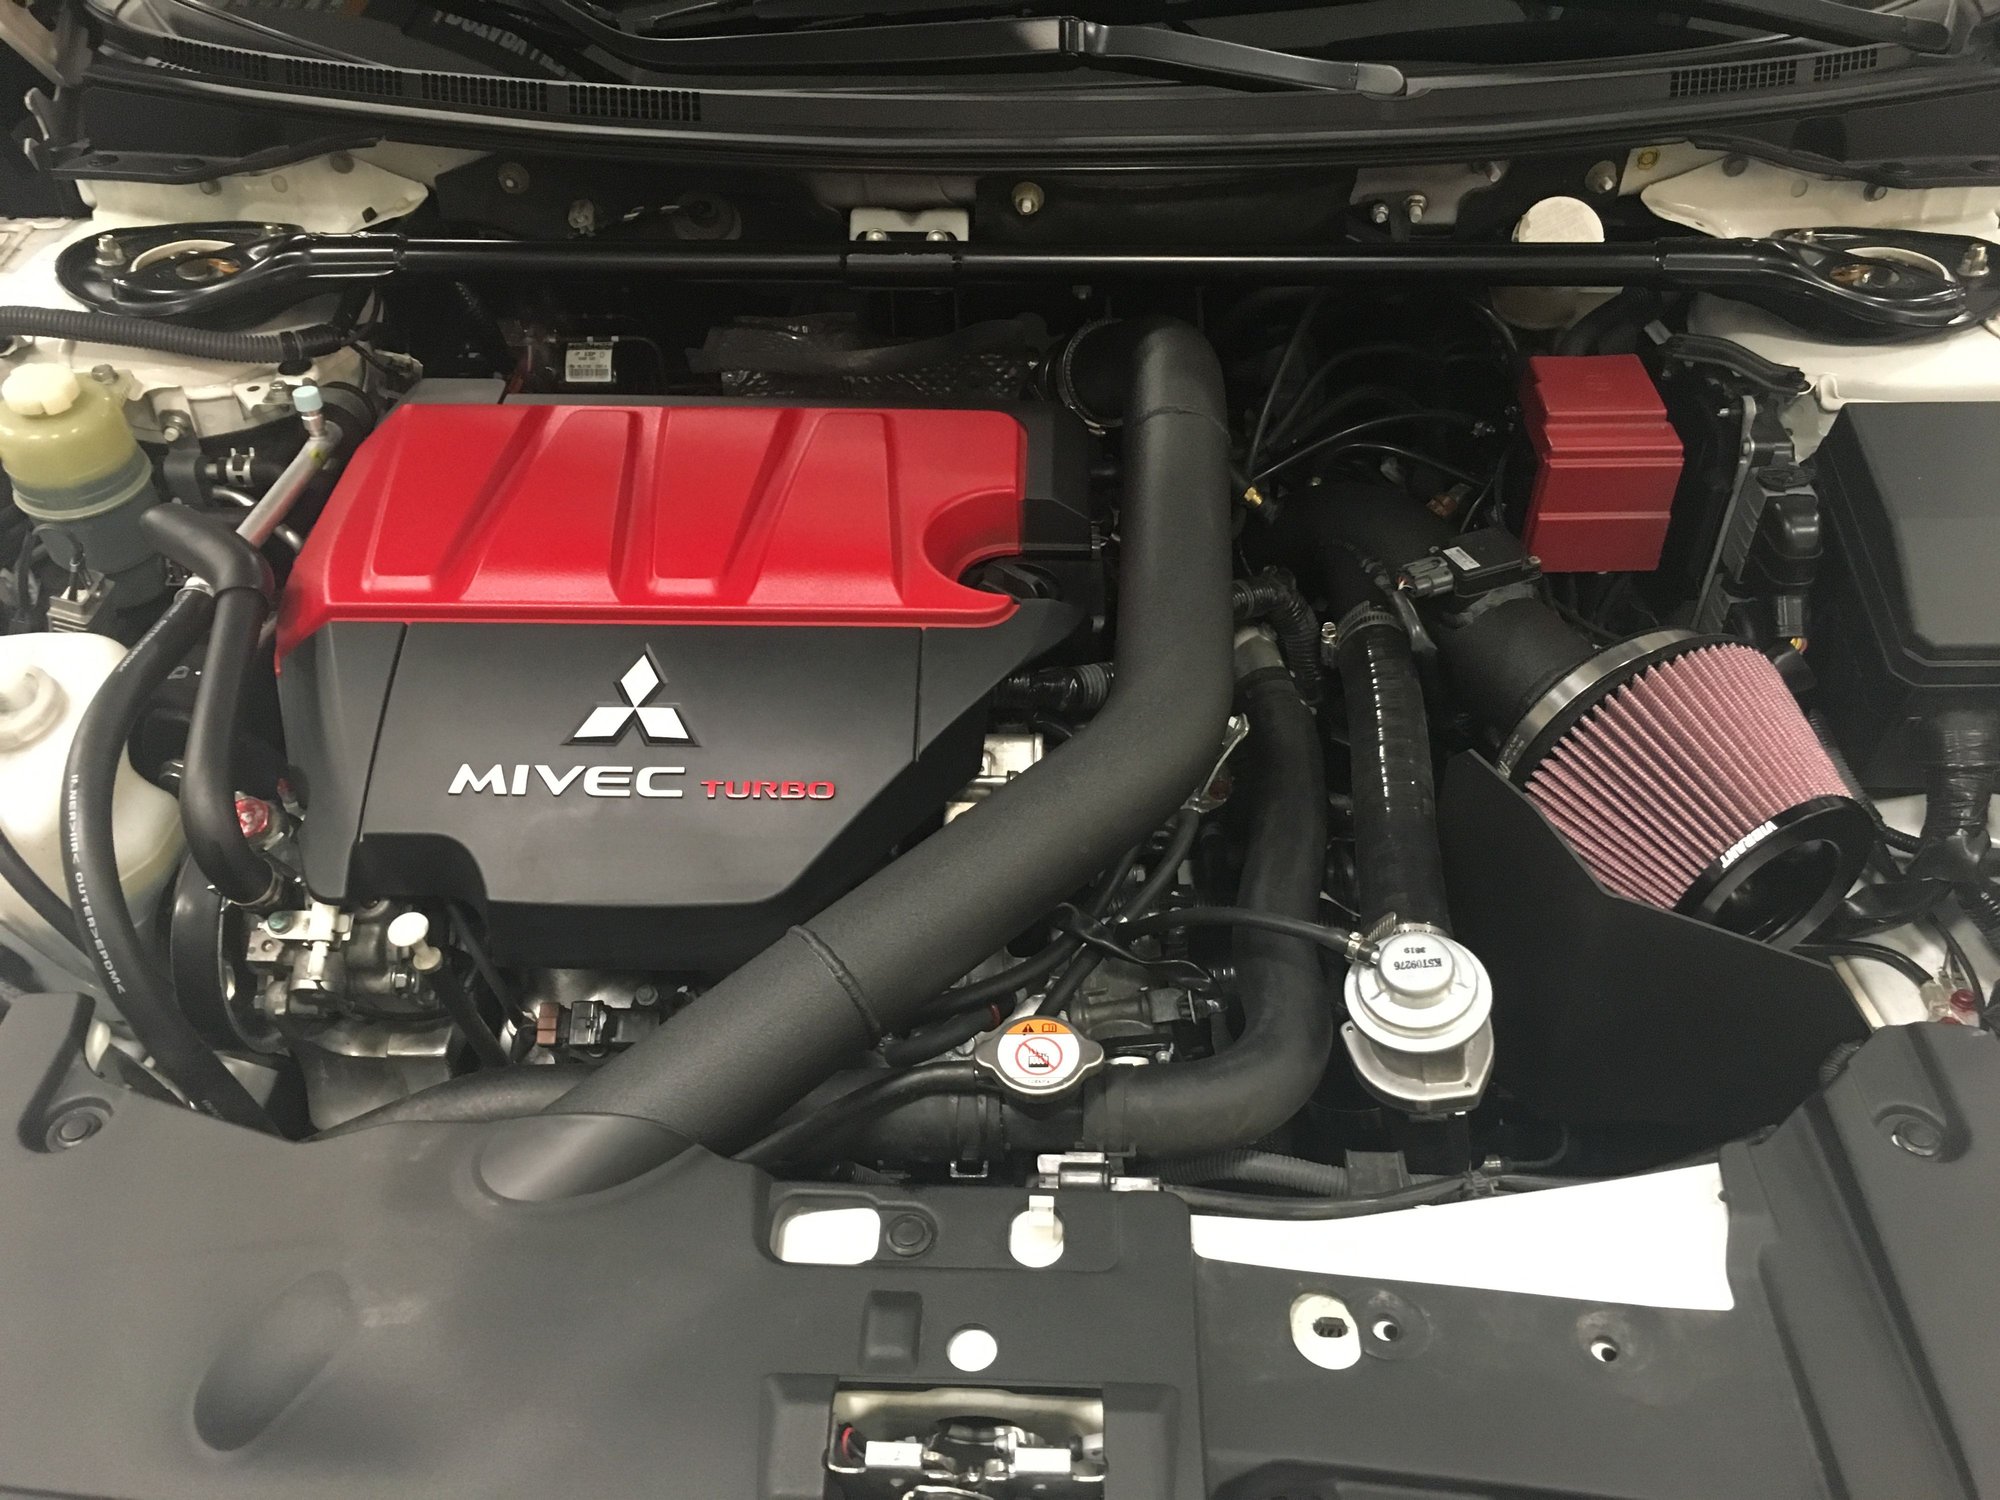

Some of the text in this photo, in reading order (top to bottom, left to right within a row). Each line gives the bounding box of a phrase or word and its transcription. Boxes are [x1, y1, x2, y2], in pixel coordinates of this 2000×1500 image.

[447, 763, 836, 800] MIVEC TURBO
[1719, 820, 1779, 869] VIBRANT
